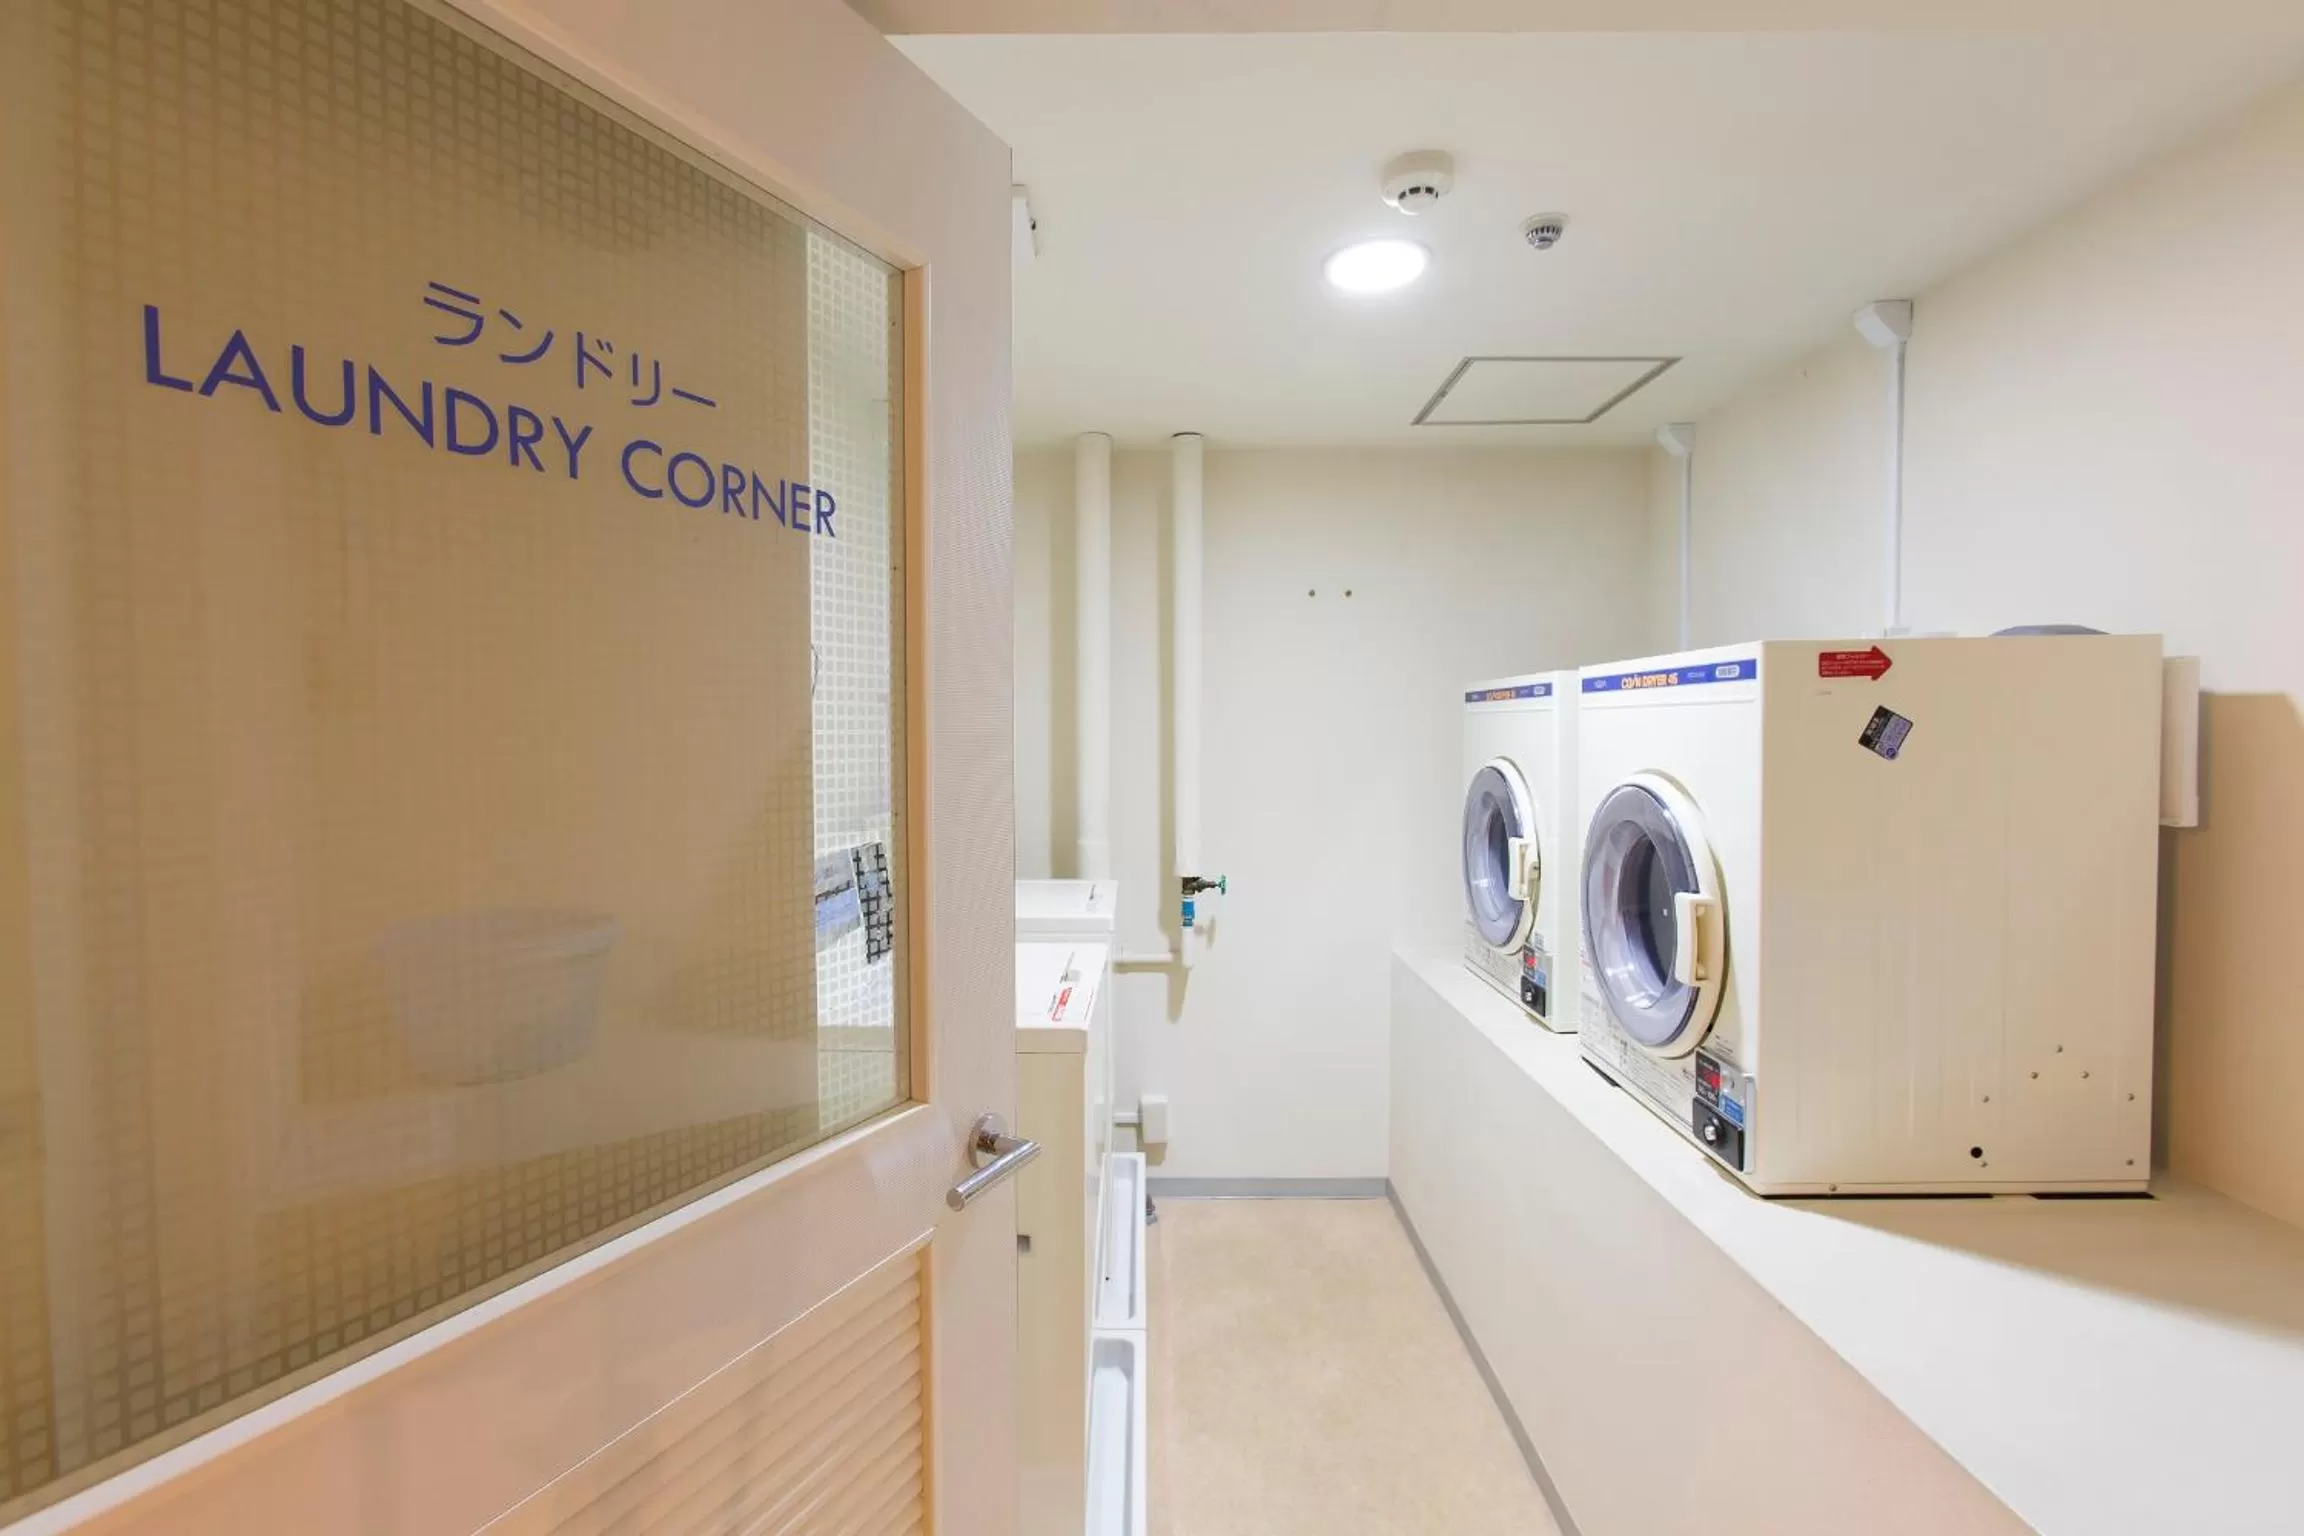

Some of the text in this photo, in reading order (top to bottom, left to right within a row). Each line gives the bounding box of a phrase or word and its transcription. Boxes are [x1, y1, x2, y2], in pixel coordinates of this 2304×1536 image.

[144, 305, 837, 537] LAUNDRY CORNER
[424, 281, 718, 408] ランドリー
